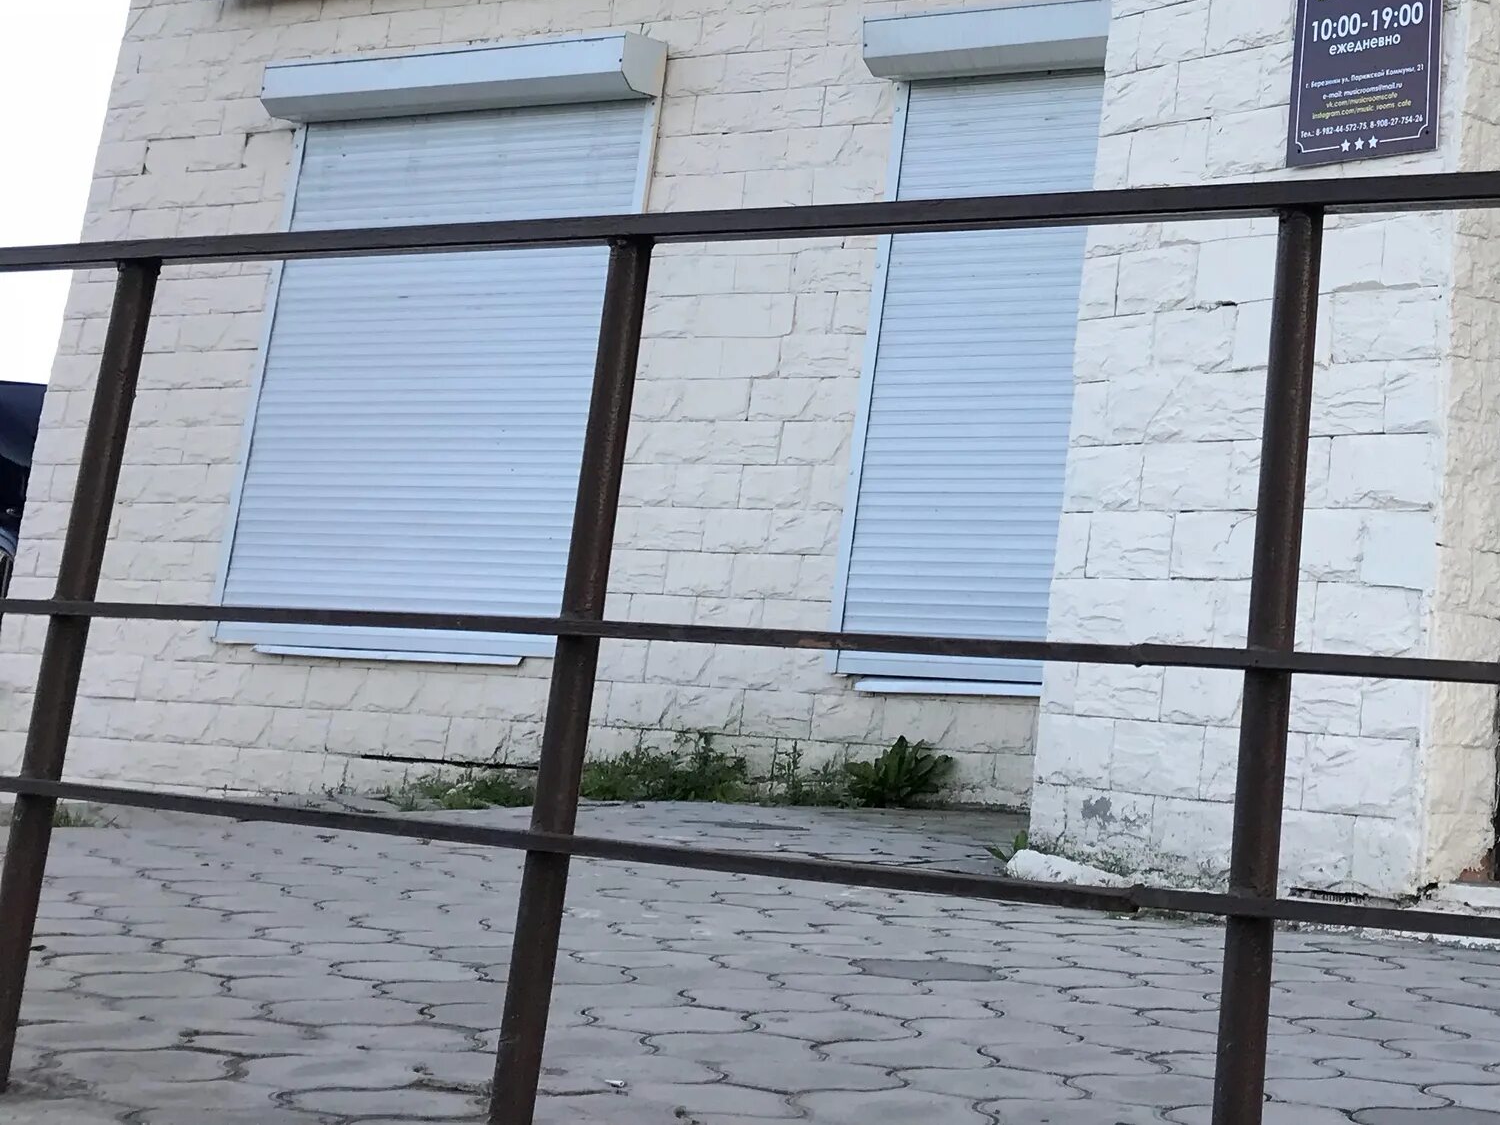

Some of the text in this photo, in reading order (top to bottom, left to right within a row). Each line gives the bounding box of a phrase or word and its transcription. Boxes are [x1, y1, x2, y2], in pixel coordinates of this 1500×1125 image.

[1312, 1, 1424, 42] 10:00-19:00
[1329, 34, 1401, 56] ежедневно
[1351, 70, 1385, 82] Парижской
[1370, 114, 1423, 129] 8-908-27-754-26
